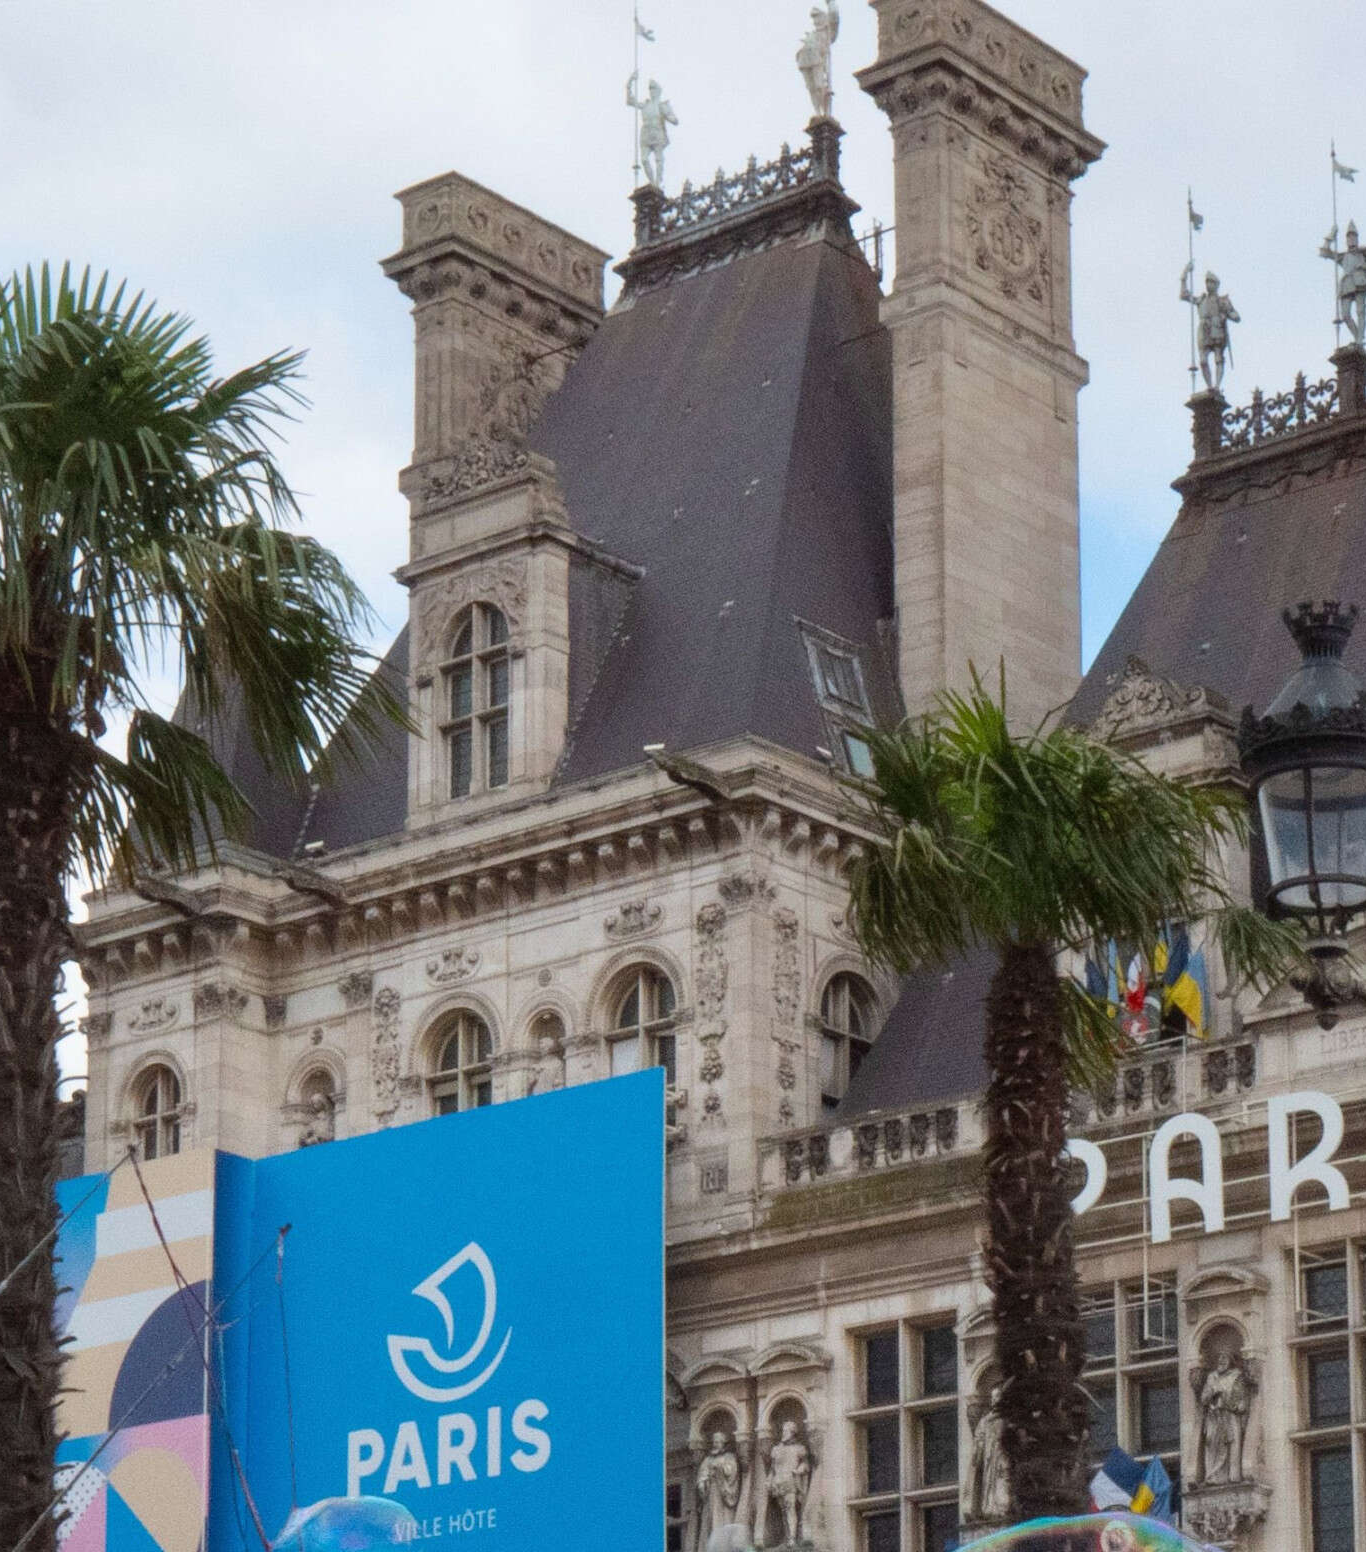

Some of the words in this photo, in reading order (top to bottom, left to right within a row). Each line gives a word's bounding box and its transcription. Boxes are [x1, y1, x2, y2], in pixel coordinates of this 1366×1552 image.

[346, 1398, 552, 1498] PARIS
[394, 1516, 442, 1544] VILLE
[449, 1507, 497, 1534] HÔTE
